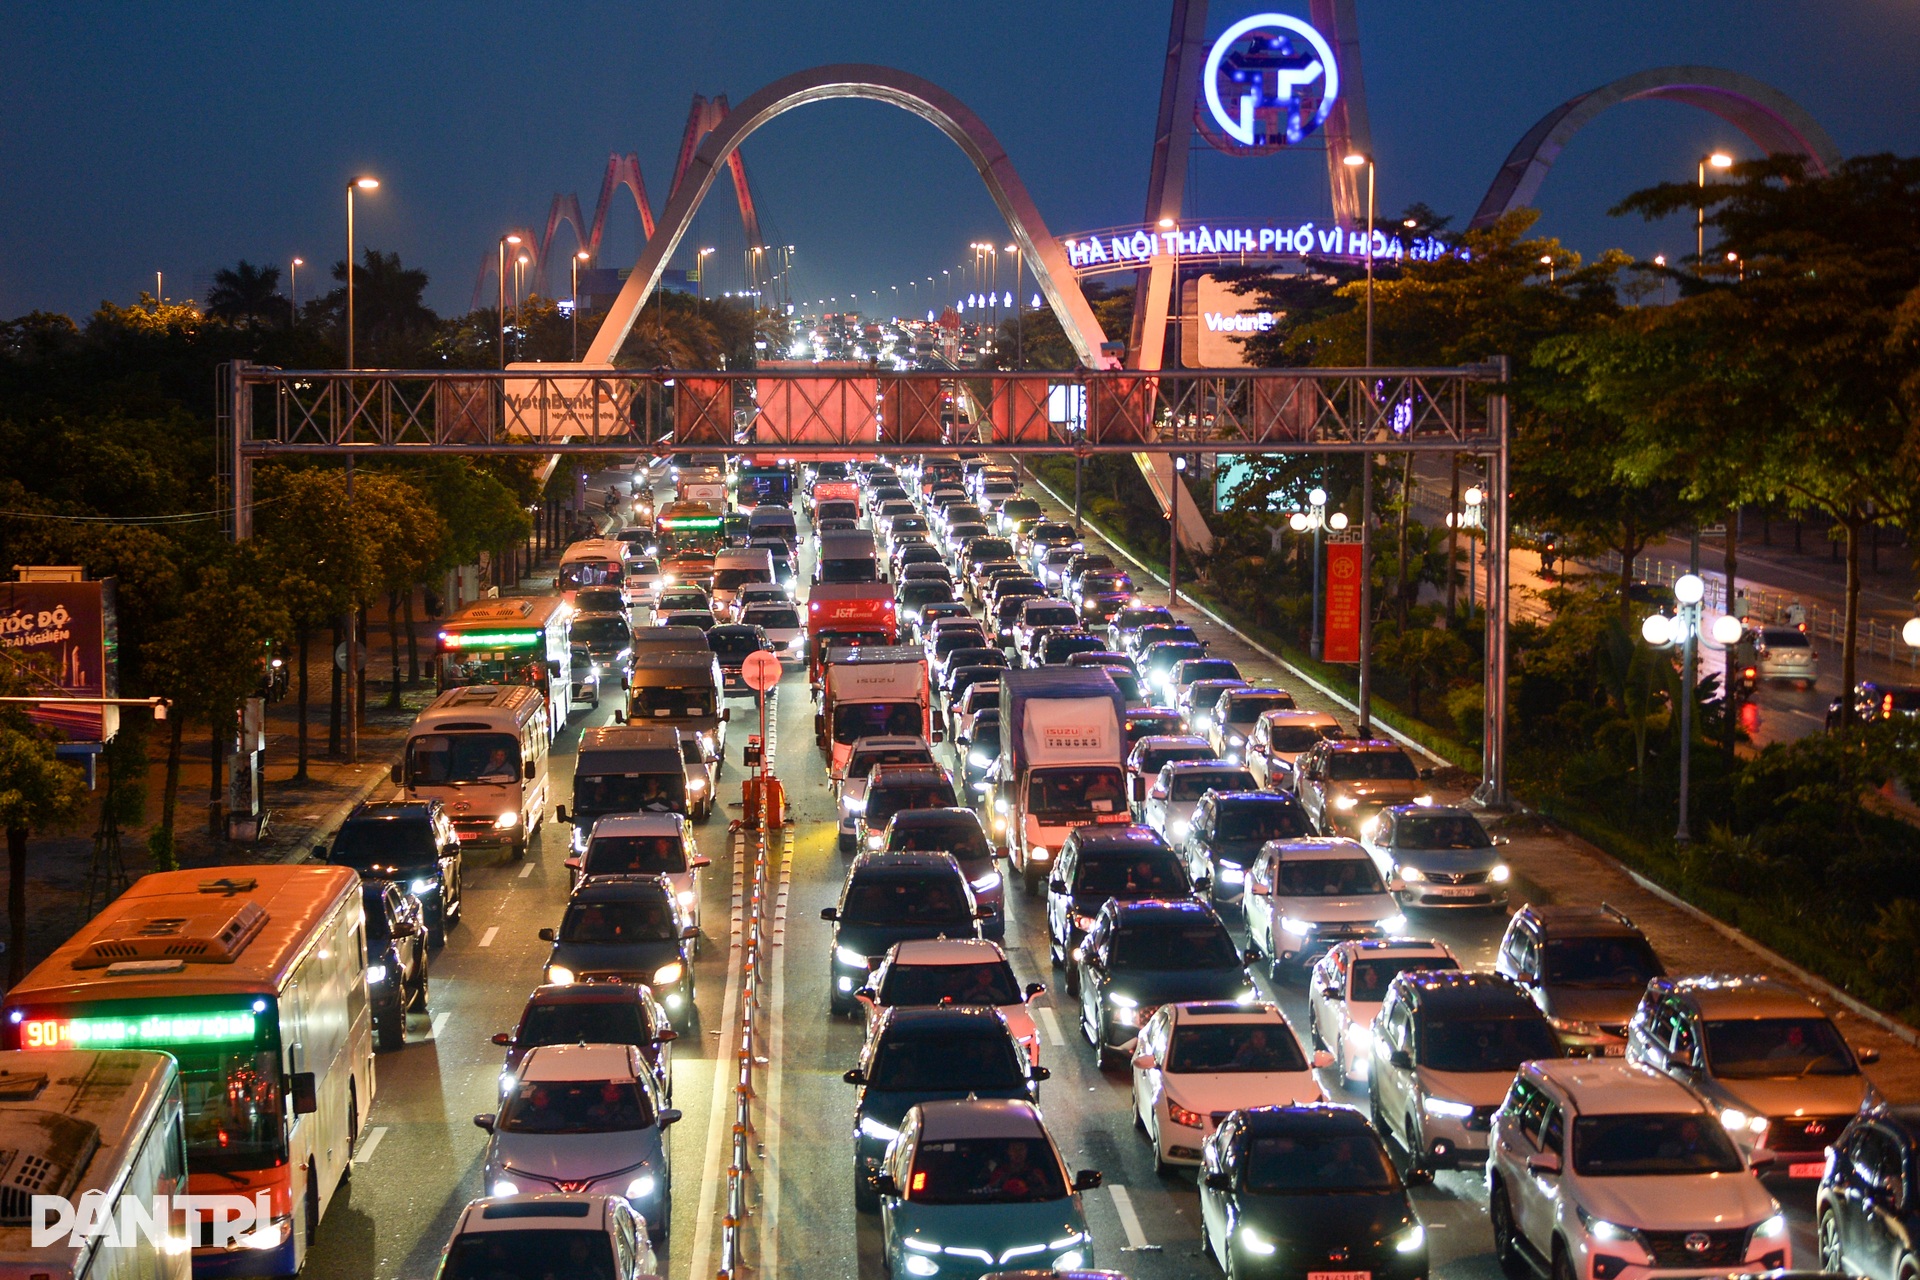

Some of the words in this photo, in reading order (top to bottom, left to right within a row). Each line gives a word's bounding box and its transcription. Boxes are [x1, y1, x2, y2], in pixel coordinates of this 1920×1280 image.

[1070, 236, 1108, 266] HÀ
[1111, 230, 1159, 262] NỘI
[1161, 225, 1252, 255] THÀNH
[1260, 222, 1314, 256] PHỐ
[1317, 226, 1344, 254] VÌ
[1048, 738, 1098, 746] TRUCKS
[27, 1021, 58, 1047] 90
